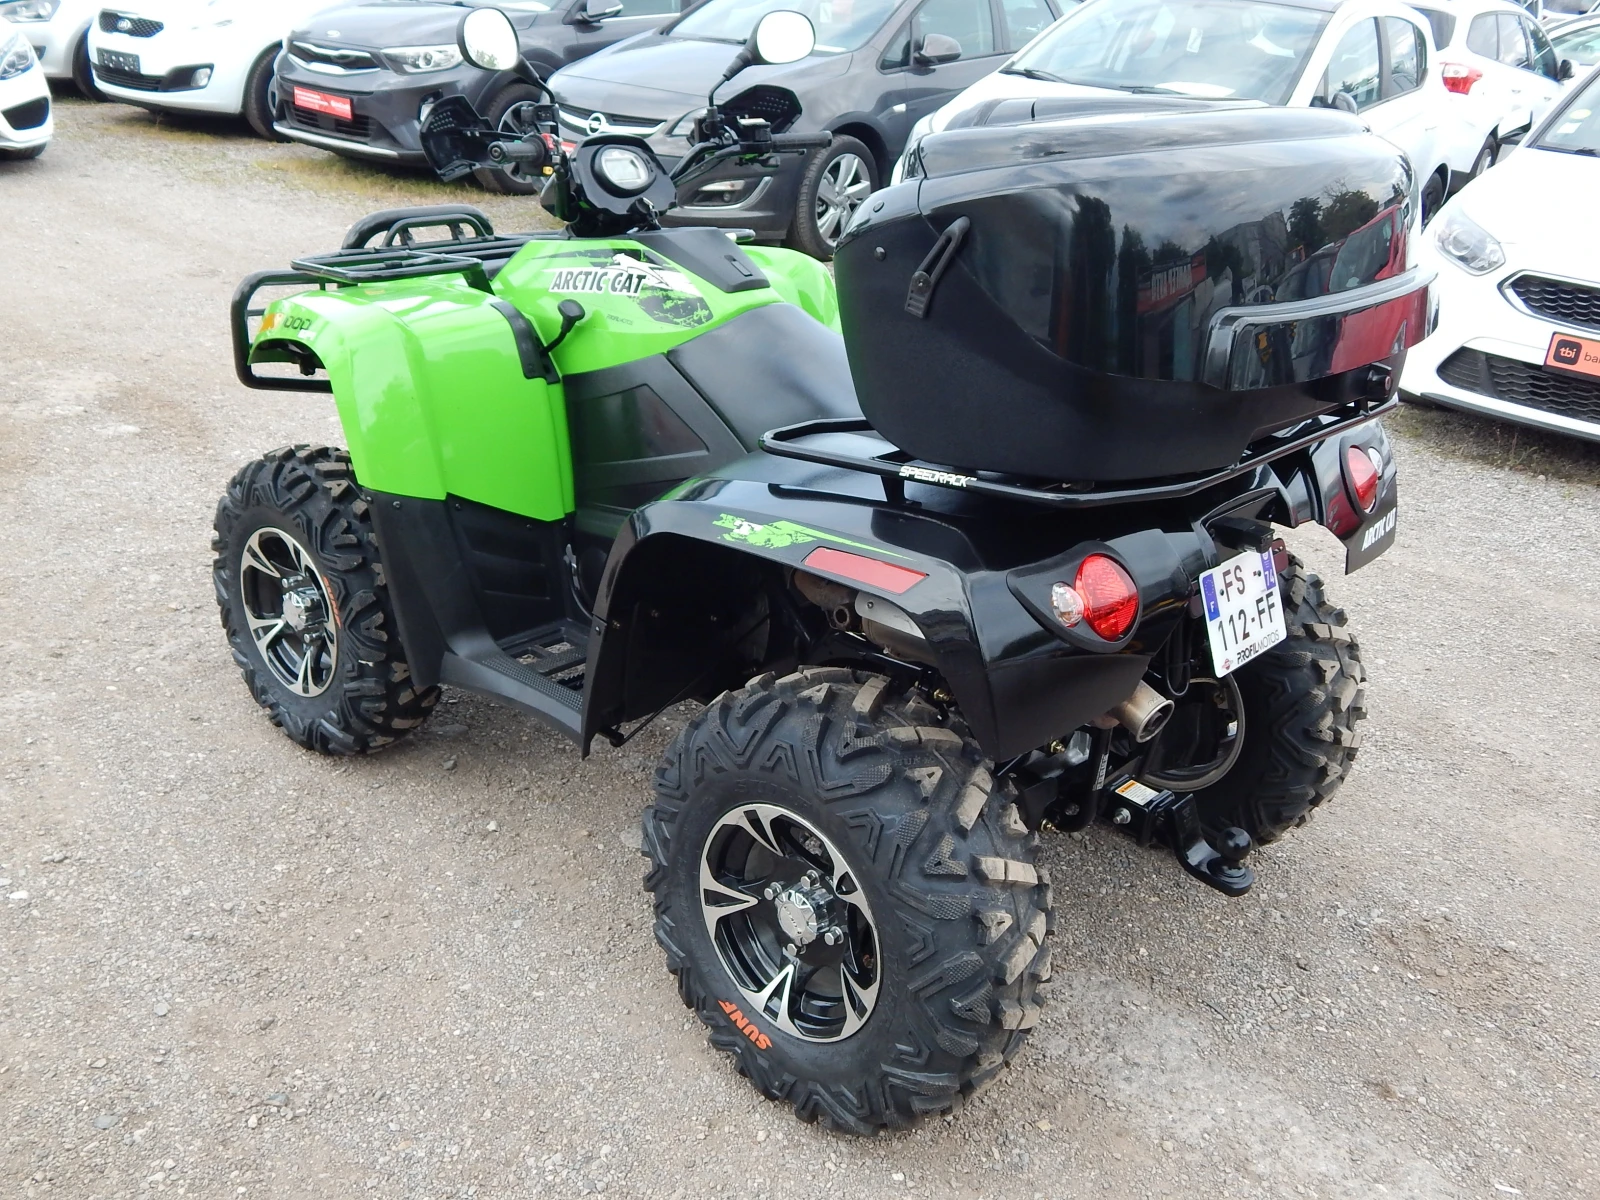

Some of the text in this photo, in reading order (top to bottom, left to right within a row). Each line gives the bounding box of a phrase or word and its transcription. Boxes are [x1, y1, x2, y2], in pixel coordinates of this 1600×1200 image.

[551, 270, 647, 294] ARCTIC CAT
[1559, 346, 1577, 359] tbi
[1583, 351, 1600, 364] ba
[898, 465, 970, 488] SPEEDRACK
[1264, 568, 1276, 588] 74
[1209, 600, 1216, 613] F
[1218, 591, 1275, 652] 112-FF
[717, 999, 773, 1050] SUNF
